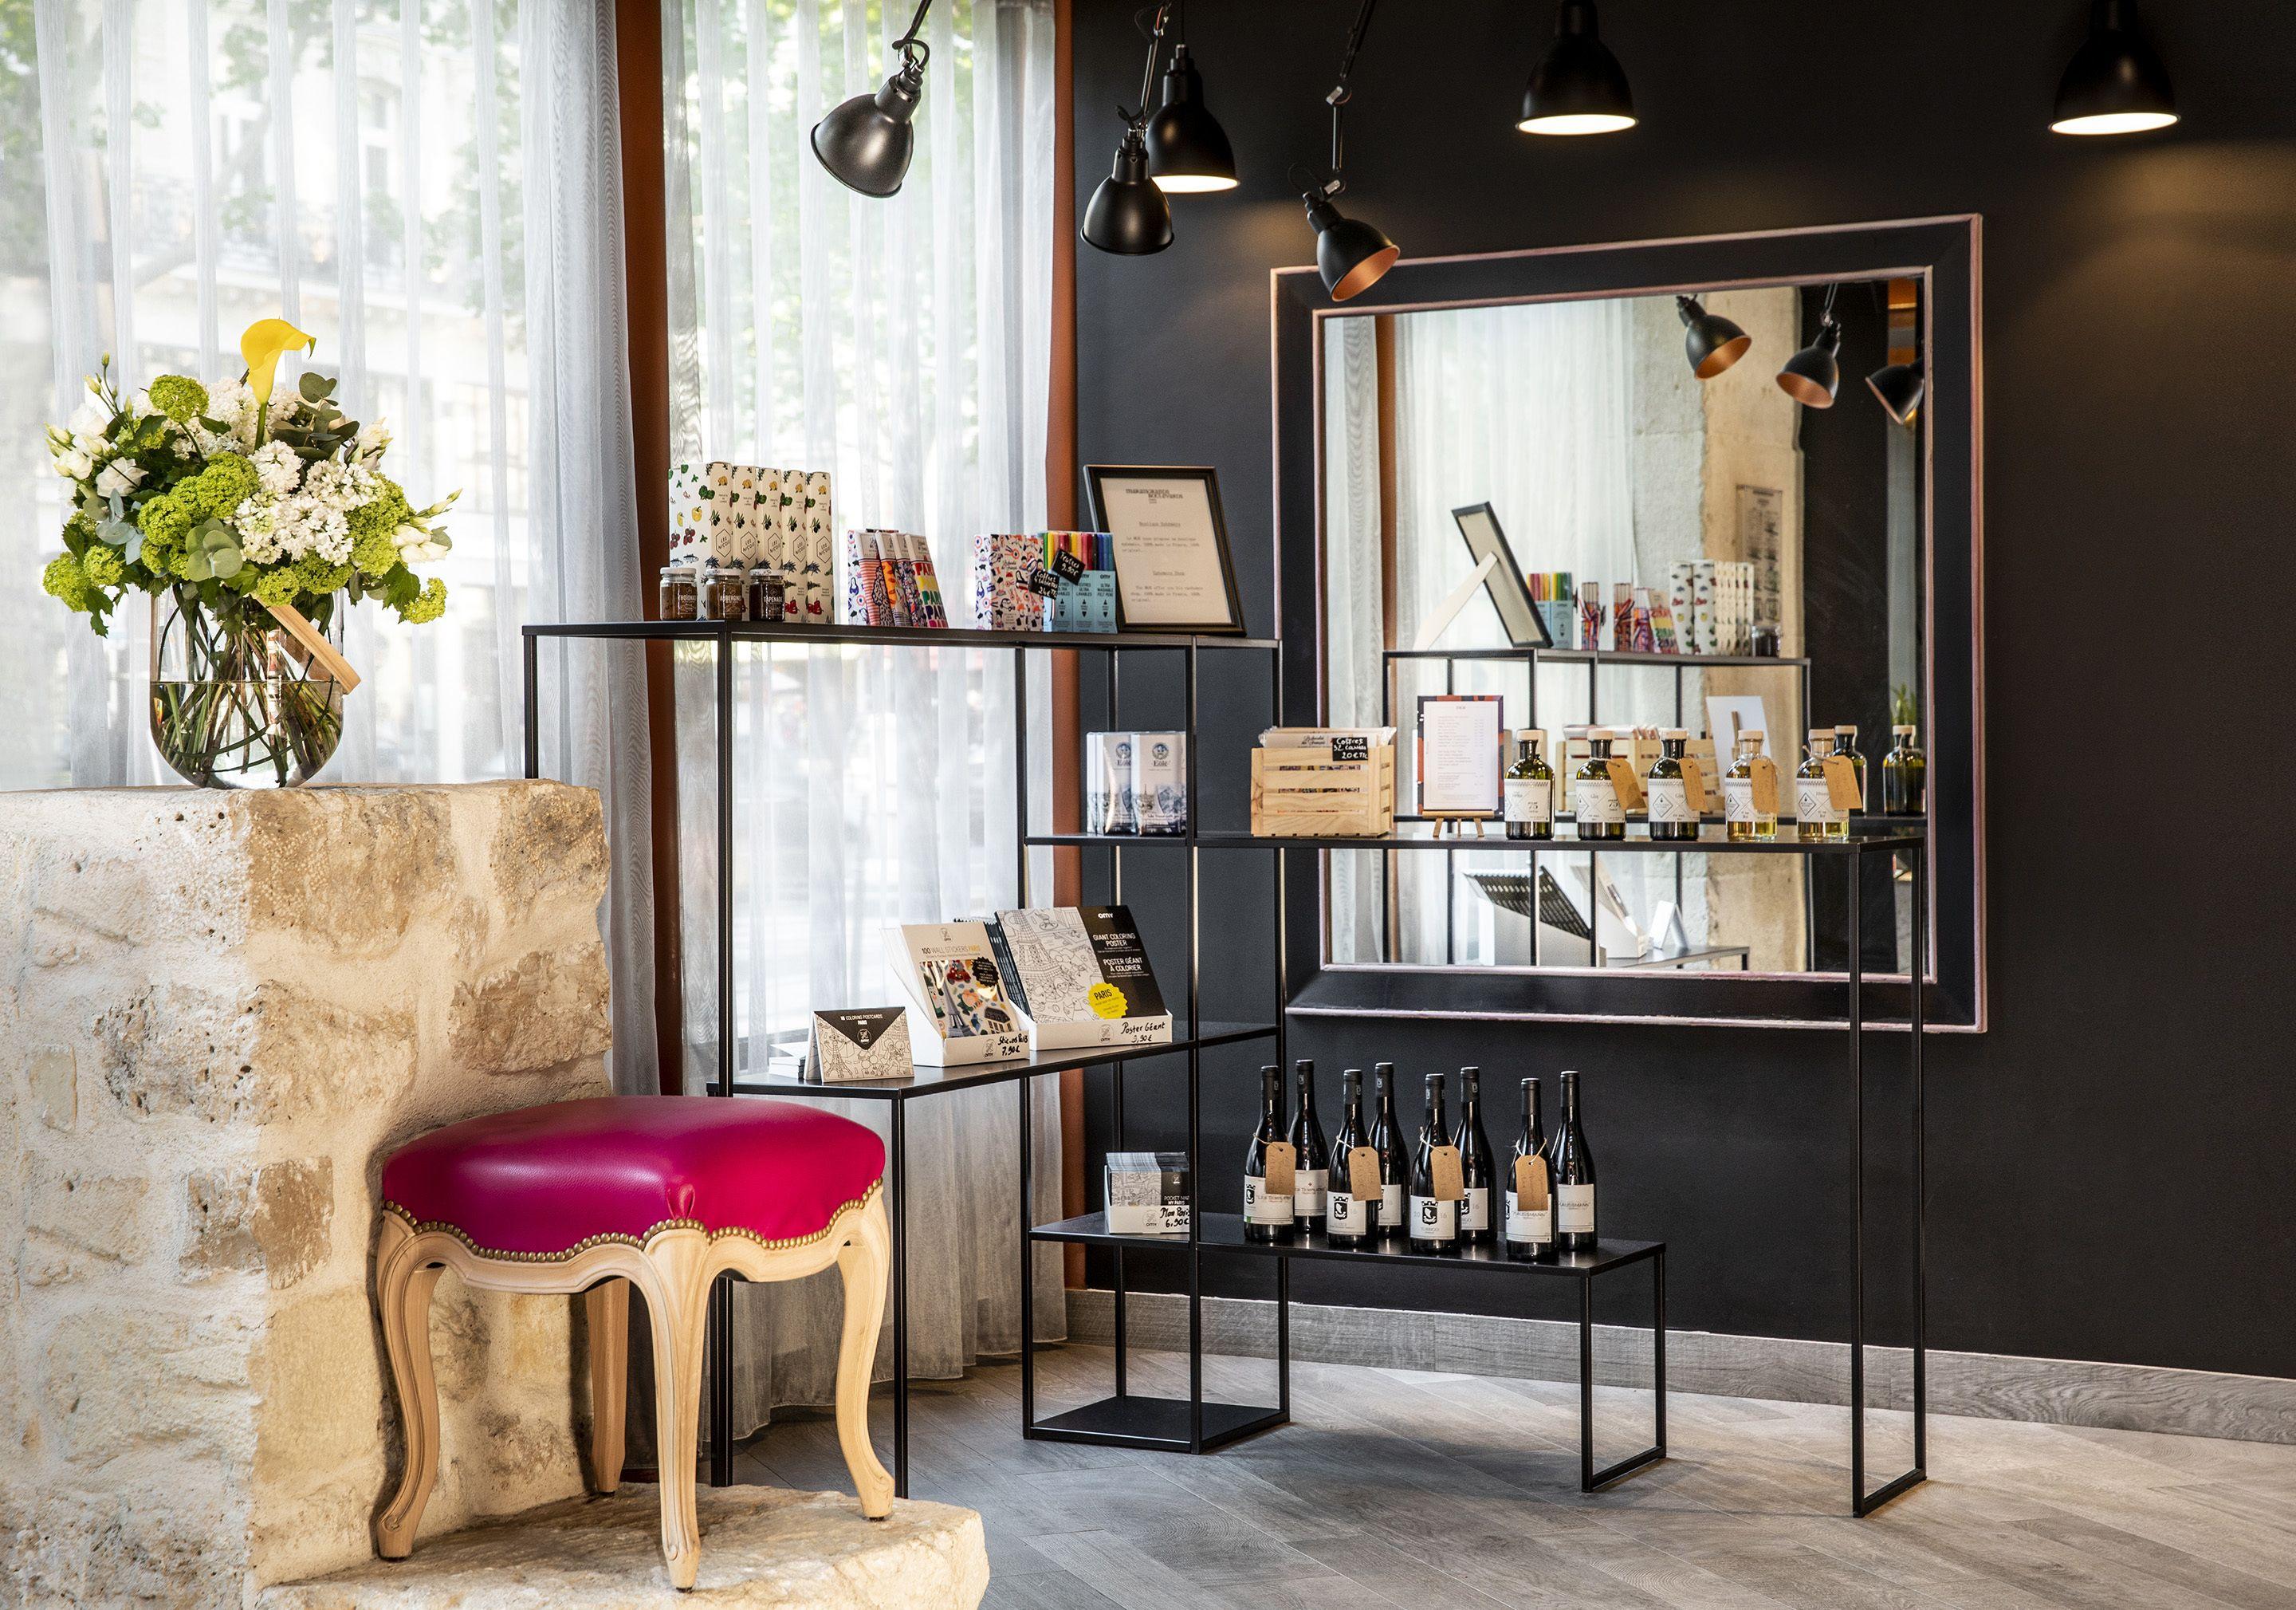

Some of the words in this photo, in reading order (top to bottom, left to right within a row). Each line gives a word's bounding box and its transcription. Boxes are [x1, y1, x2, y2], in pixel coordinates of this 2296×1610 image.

[1094, 989, 1112, 1001] PARIS
[1121, 1022, 1143, 1034] Poster
[1145, 1022, 1165, 1031] Géant
[1160, 1207, 1175, 1218] Plan
